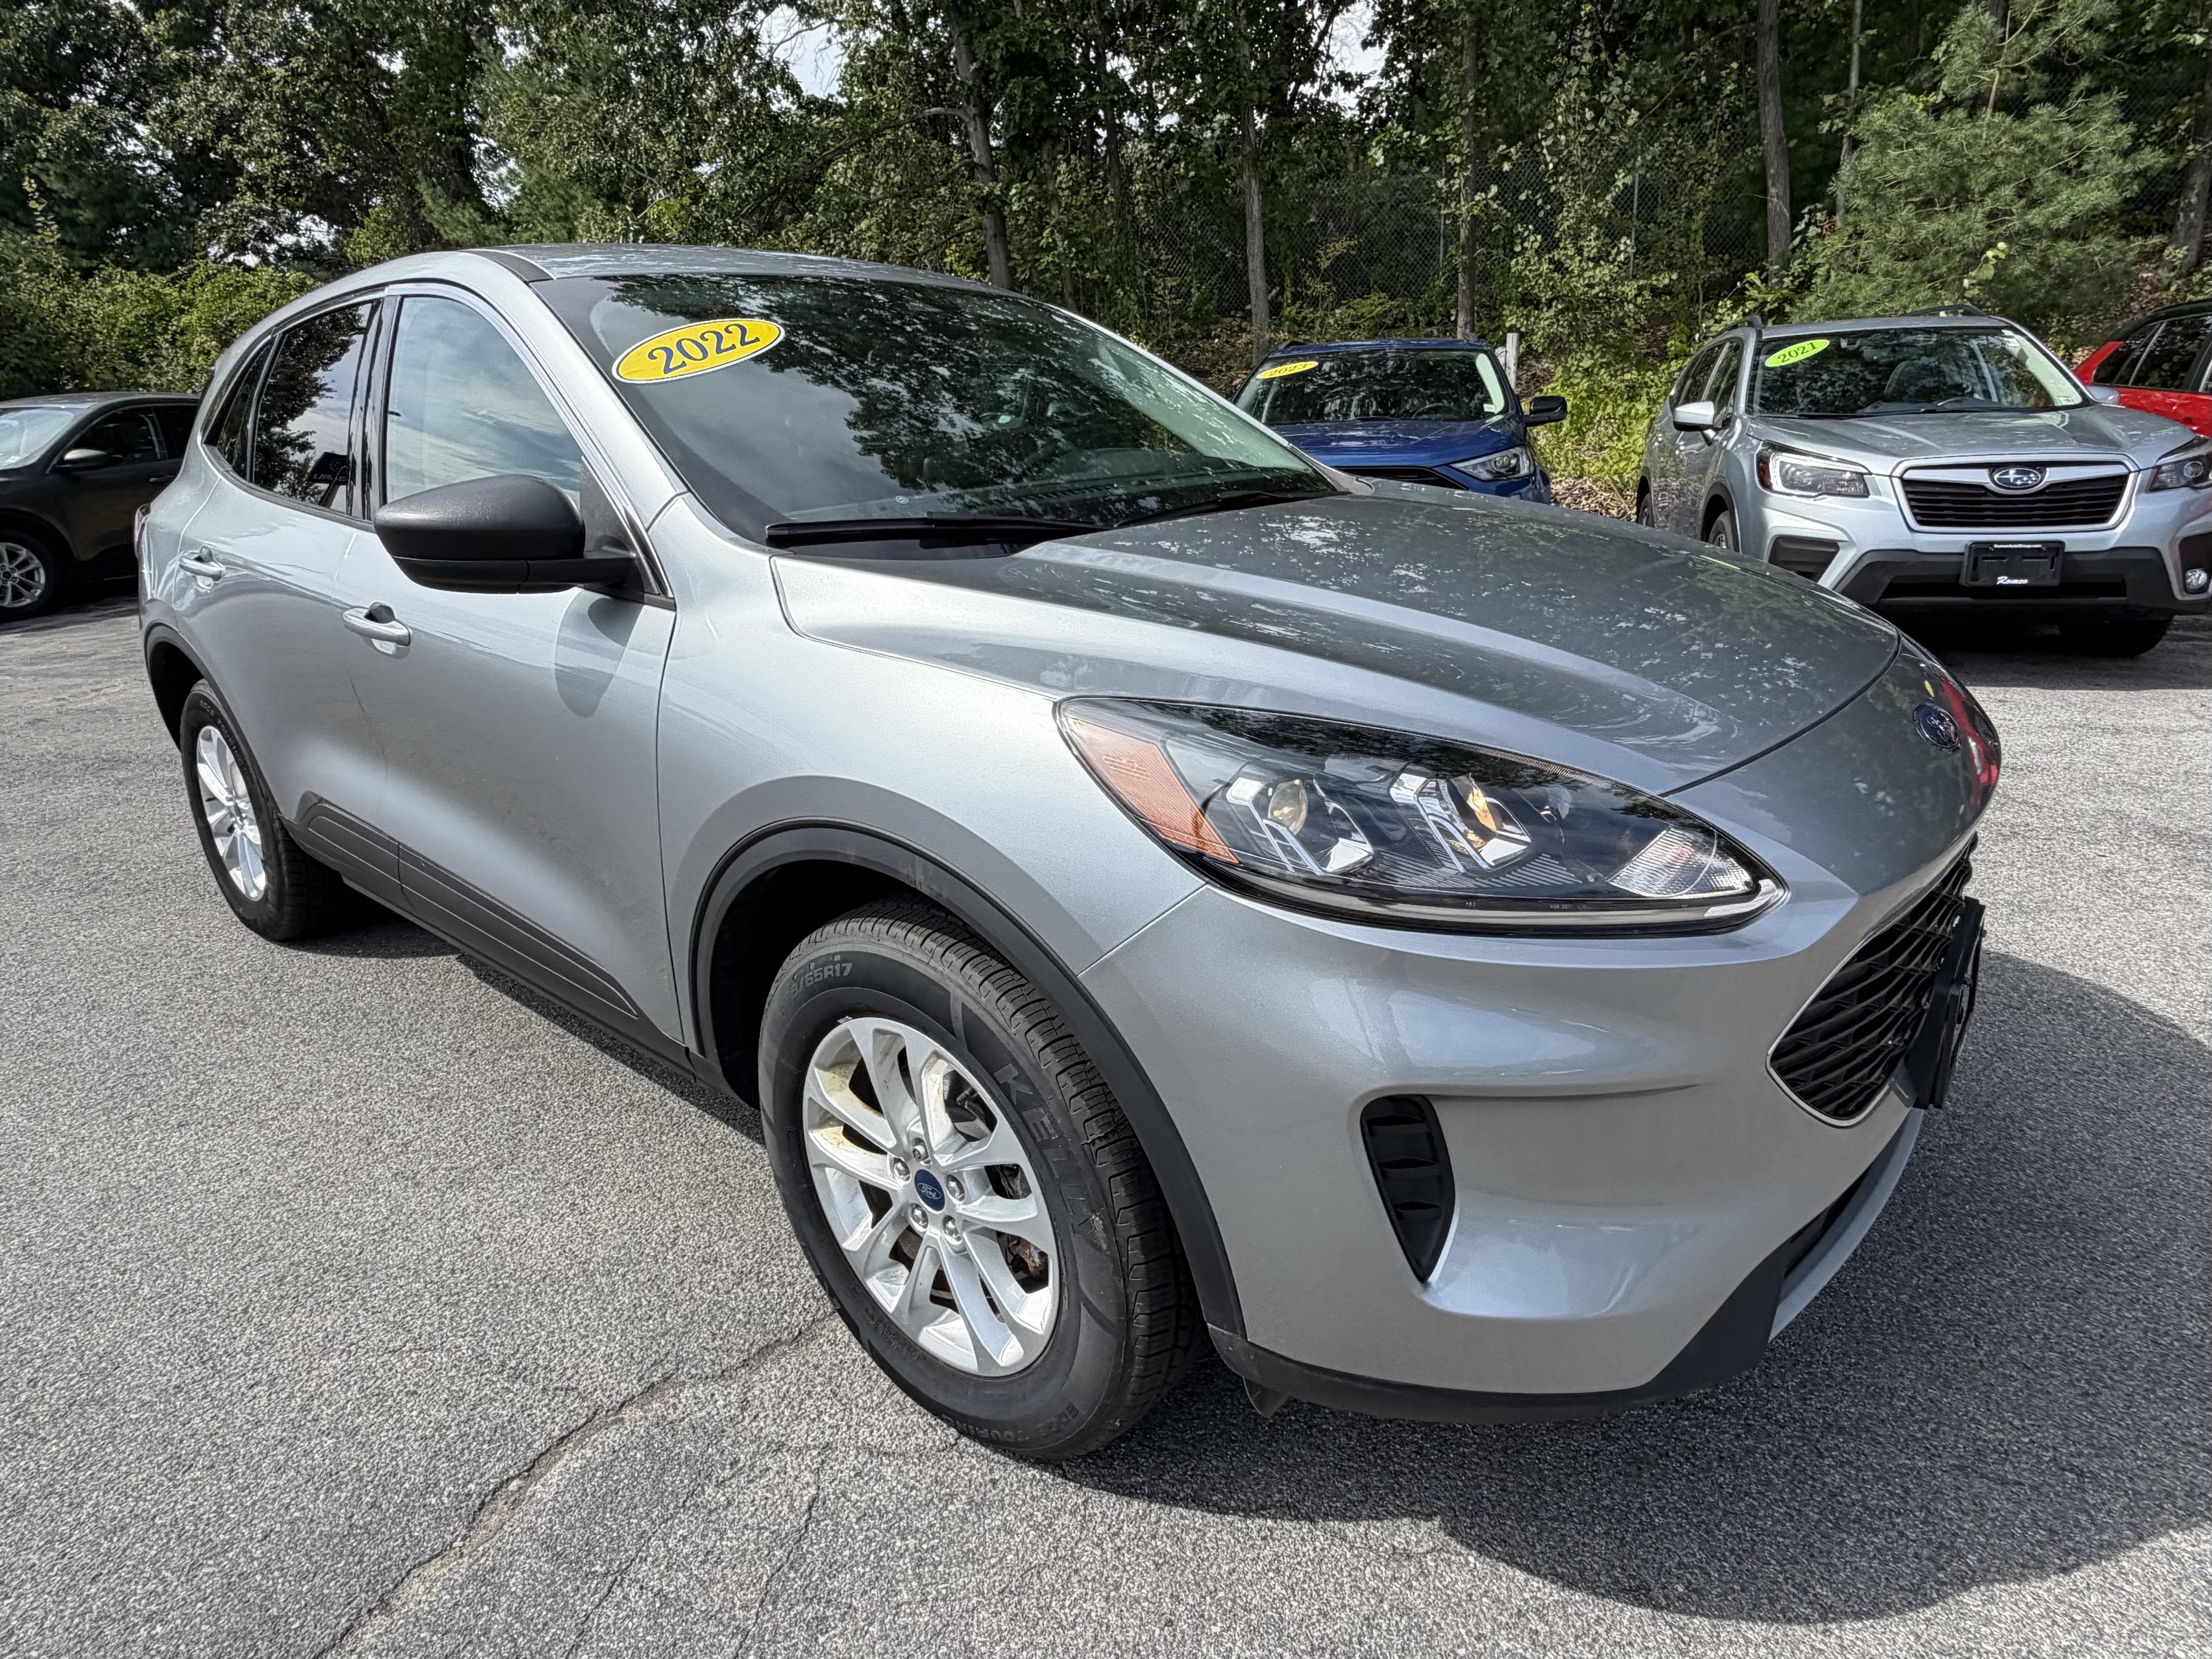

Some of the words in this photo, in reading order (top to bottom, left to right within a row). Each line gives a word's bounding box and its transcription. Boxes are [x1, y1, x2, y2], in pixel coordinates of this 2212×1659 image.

[648, 324, 760, 374] 2022
[1778, 342, 1818, 362] 2021
[921, 1185, 937, 1197] Ford
